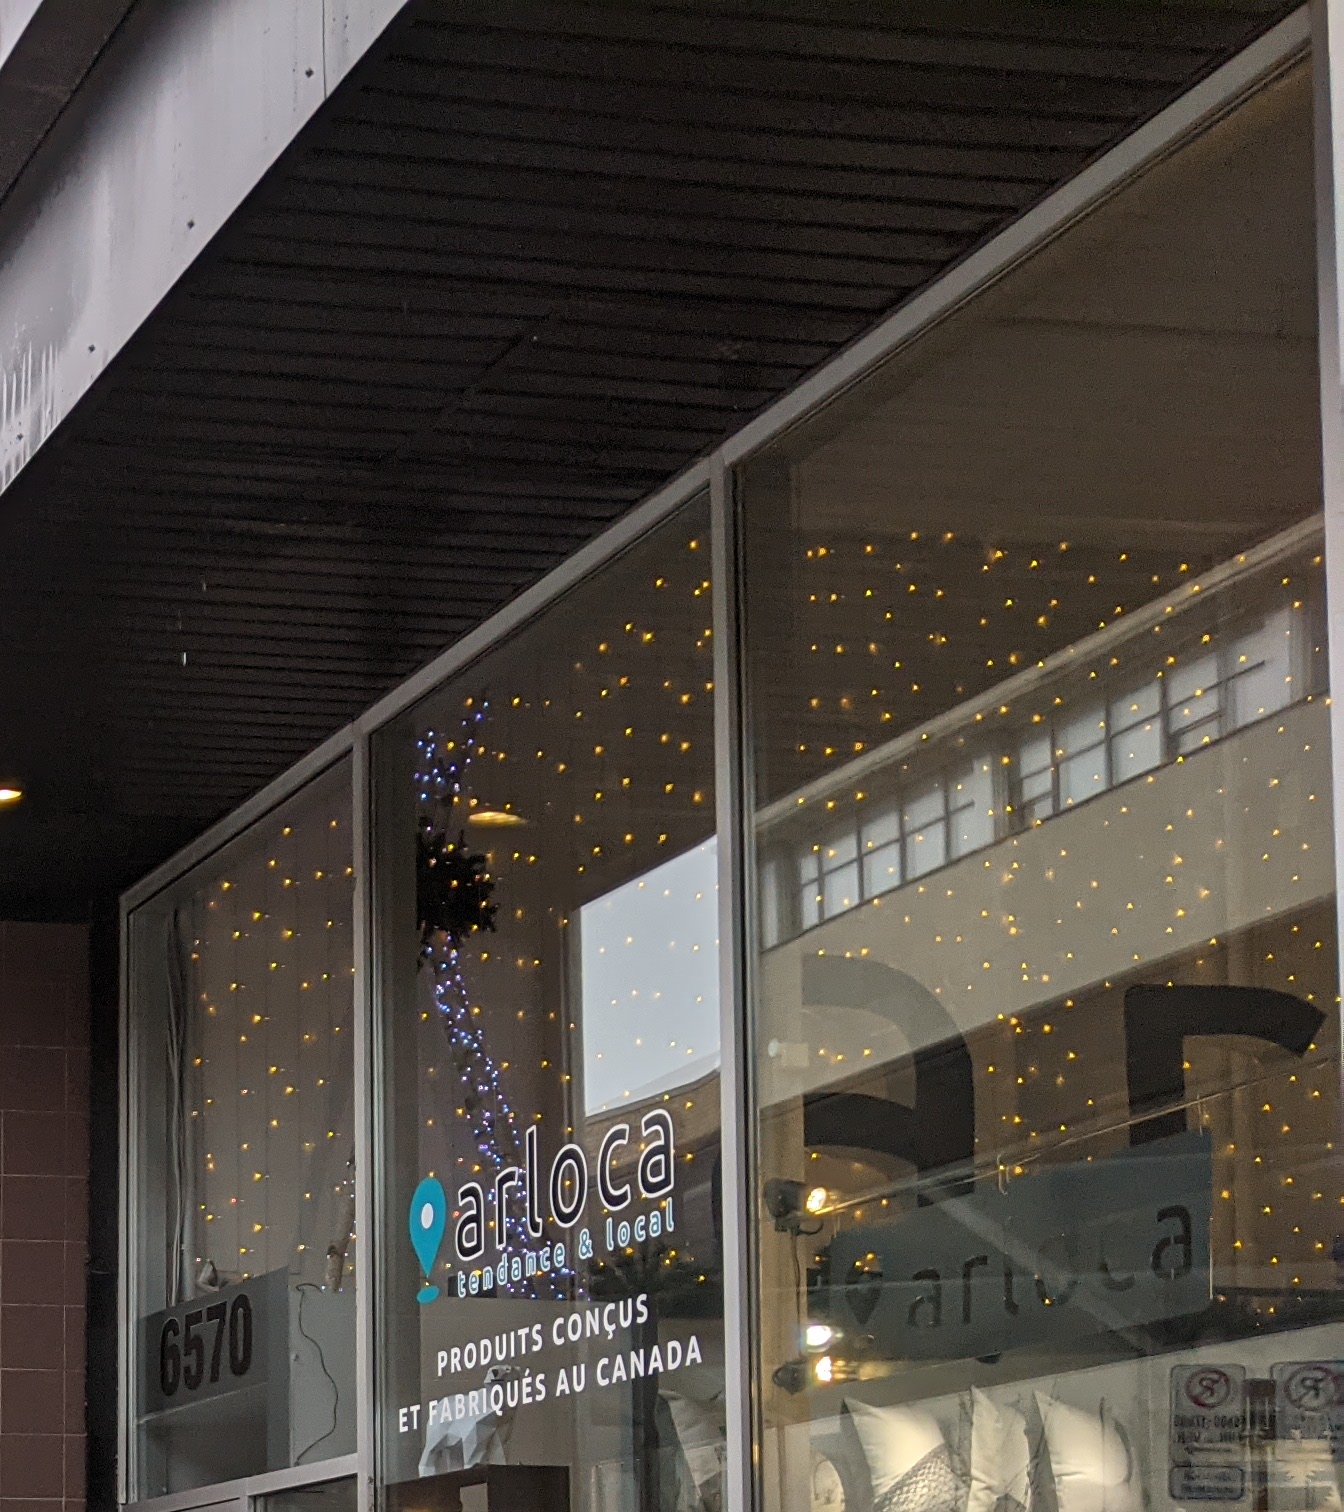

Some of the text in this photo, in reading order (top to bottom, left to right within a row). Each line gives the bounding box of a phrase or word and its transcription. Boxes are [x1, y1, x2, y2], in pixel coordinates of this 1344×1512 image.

[455, 1109, 674, 1261] arloca
[457, 1197, 674, 1298] tendance & local
[158, 1293, 253, 1397] 6570
[398, 1335, 703, 1433] ET FABRIQUÉS AU CANADA
[437, 1294, 649, 1377] PRODUITS CONÇUS
